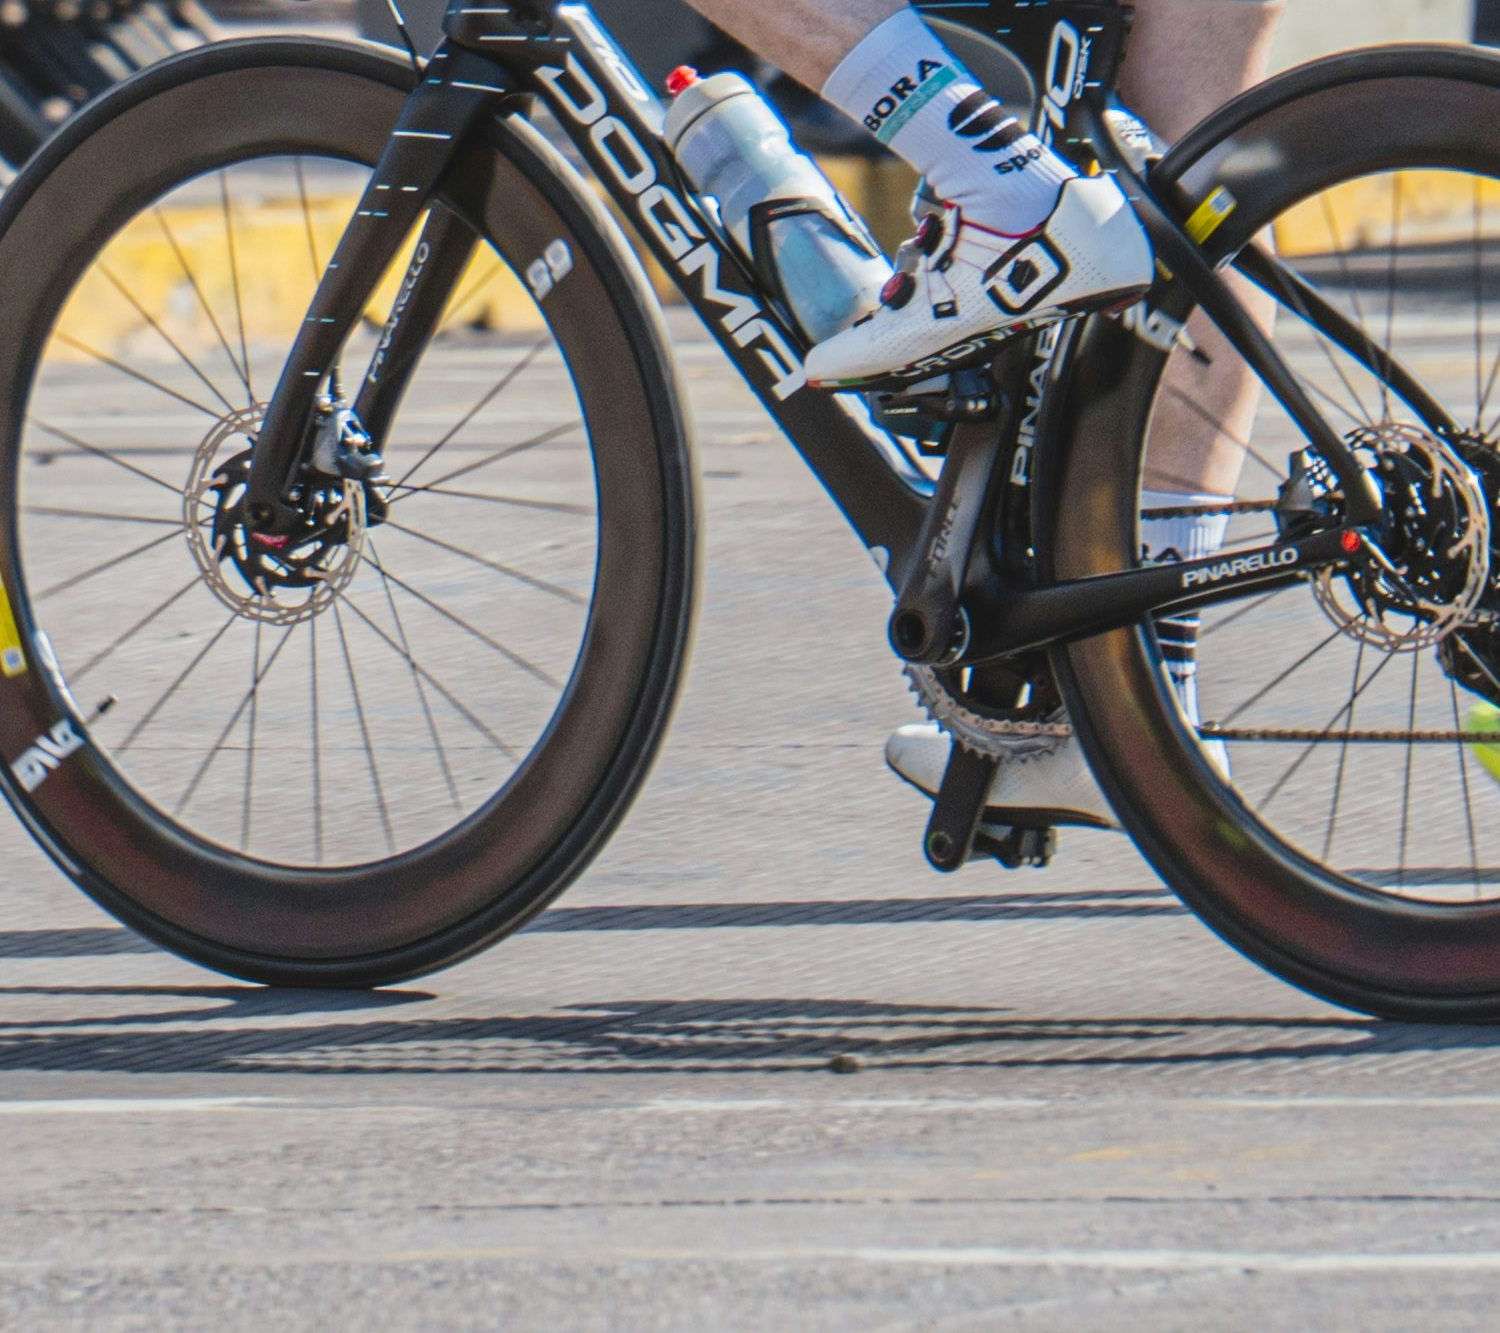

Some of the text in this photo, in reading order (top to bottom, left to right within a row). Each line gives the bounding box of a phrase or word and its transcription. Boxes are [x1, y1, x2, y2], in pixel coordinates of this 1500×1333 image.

[863, 58, 943, 133] BORA
[1073, 35, 1093, 100] DISK
[533, 52, 807, 402] DOGMA
[1181, 547, 1299, 588] PINARELLO
